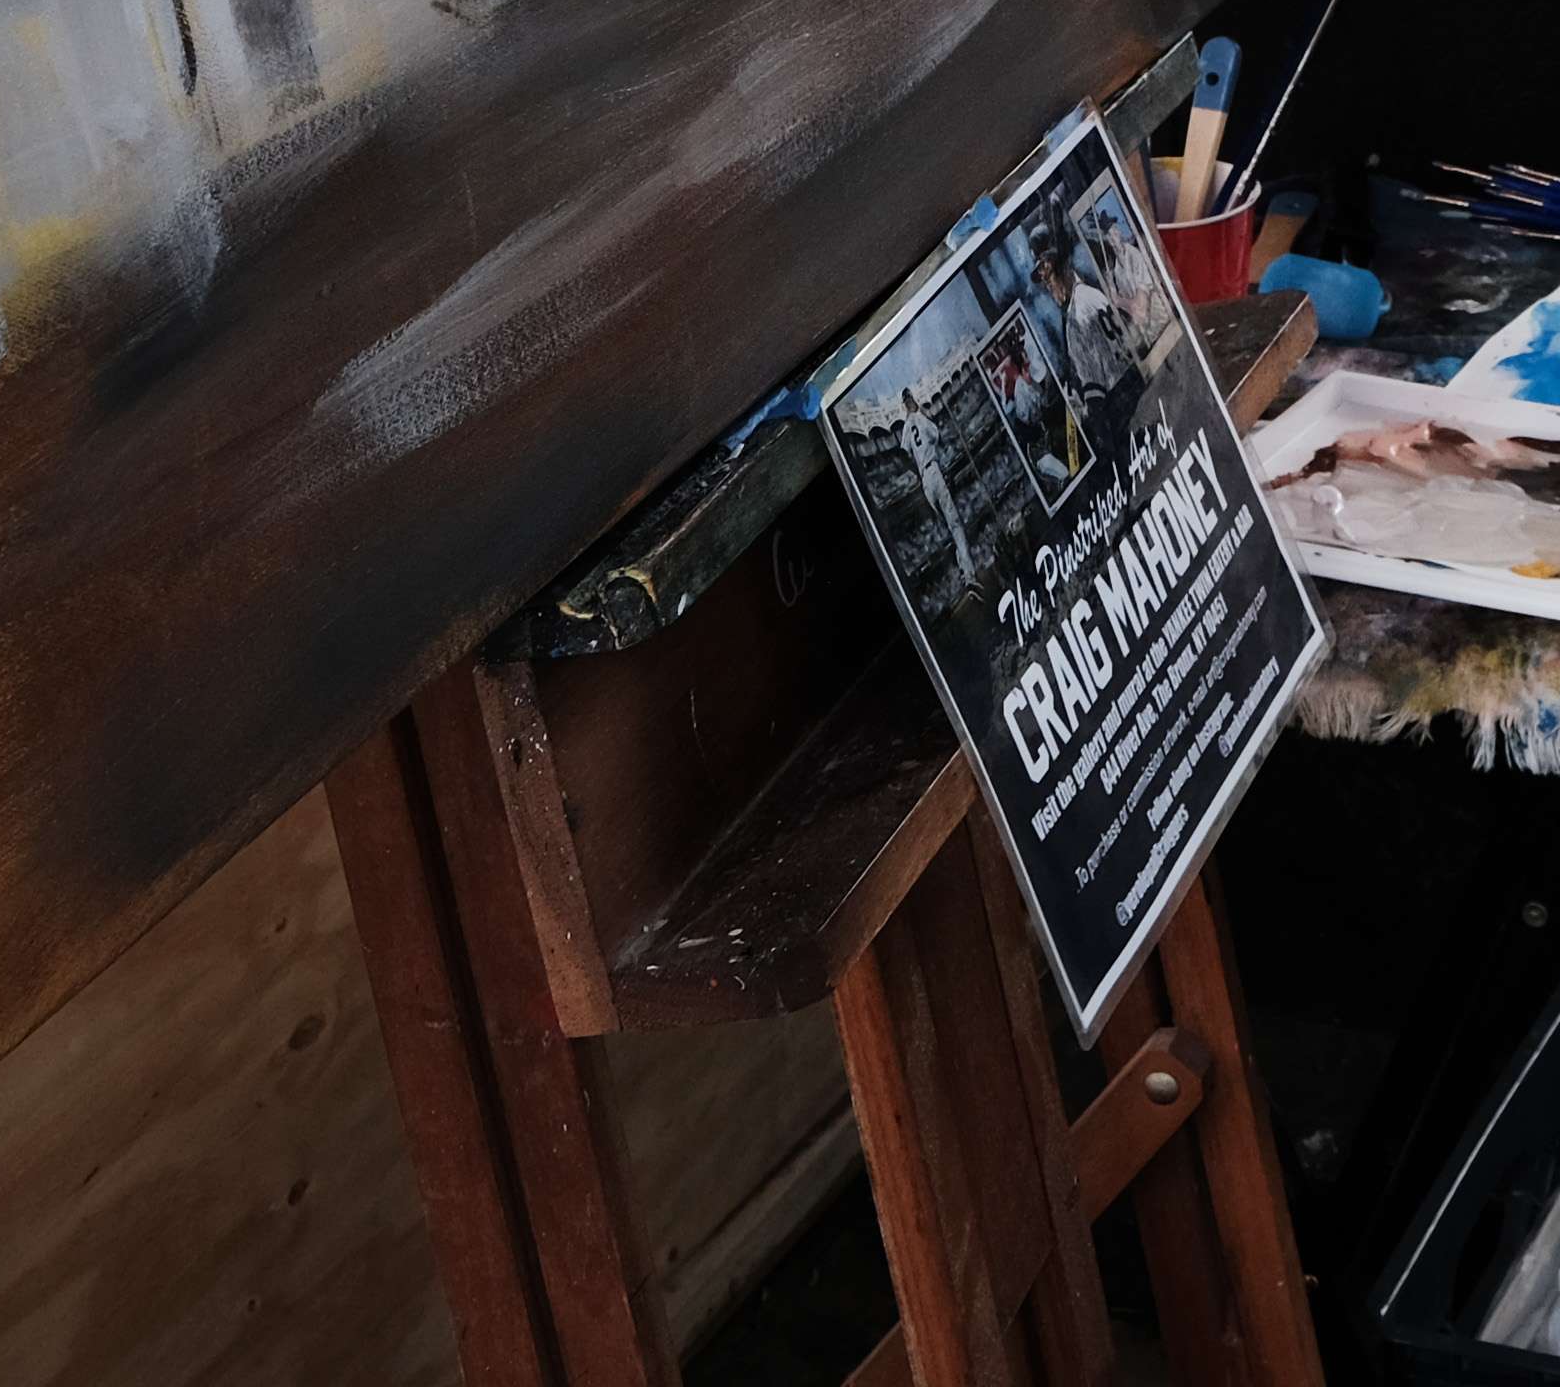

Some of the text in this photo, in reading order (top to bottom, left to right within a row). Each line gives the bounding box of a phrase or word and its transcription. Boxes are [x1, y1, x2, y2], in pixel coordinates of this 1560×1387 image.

[997, 398, 1178, 648] The Pinstriped Art of
[1003, 597, 1113, 784] CRAIG
[1093, 427, 1228, 658] MAHONEY
[1031, 794, 1062, 841] Visit
[1054, 775, 1077, 810] the
[1072, 728, 1107, 790] gallery
[1101, 700, 1122, 743] and
[1117, 664, 1147, 719] mural
[1141, 653, 1156, 682] at
[1149, 637, 1169, 669] the
[1161, 593, 1196, 649] YANKEE
[1188, 565, 1215, 610] TWIN
[1207, 530, 1235, 583] EATERY
[1086, 818, 1122, 880] purchase
[1119, 804, 1129, 826] or
[1126, 747, 1165, 813] commission
[1162, 709, 1190, 756] artwork,
[1187, 676, 1208, 716] e-mail
[1099, 591, 1229, 795] 844 River Ave, The Bronx, NY 10451
